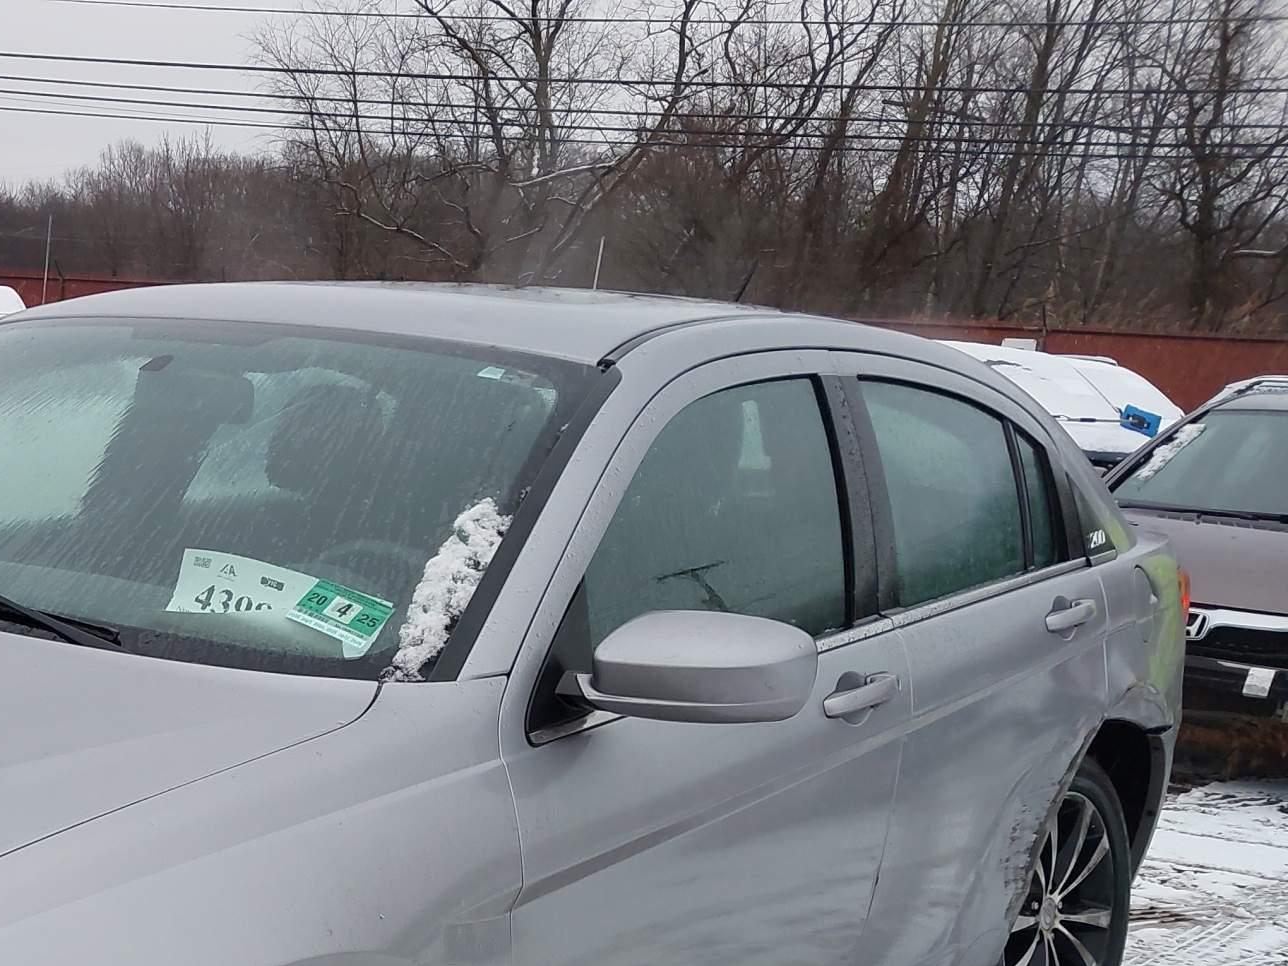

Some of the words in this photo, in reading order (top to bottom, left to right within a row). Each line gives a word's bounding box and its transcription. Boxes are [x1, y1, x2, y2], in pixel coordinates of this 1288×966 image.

[307, 592, 328, 606] 20
[336, 603, 354, 618] 4
[357, 613, 380, 628] 25
